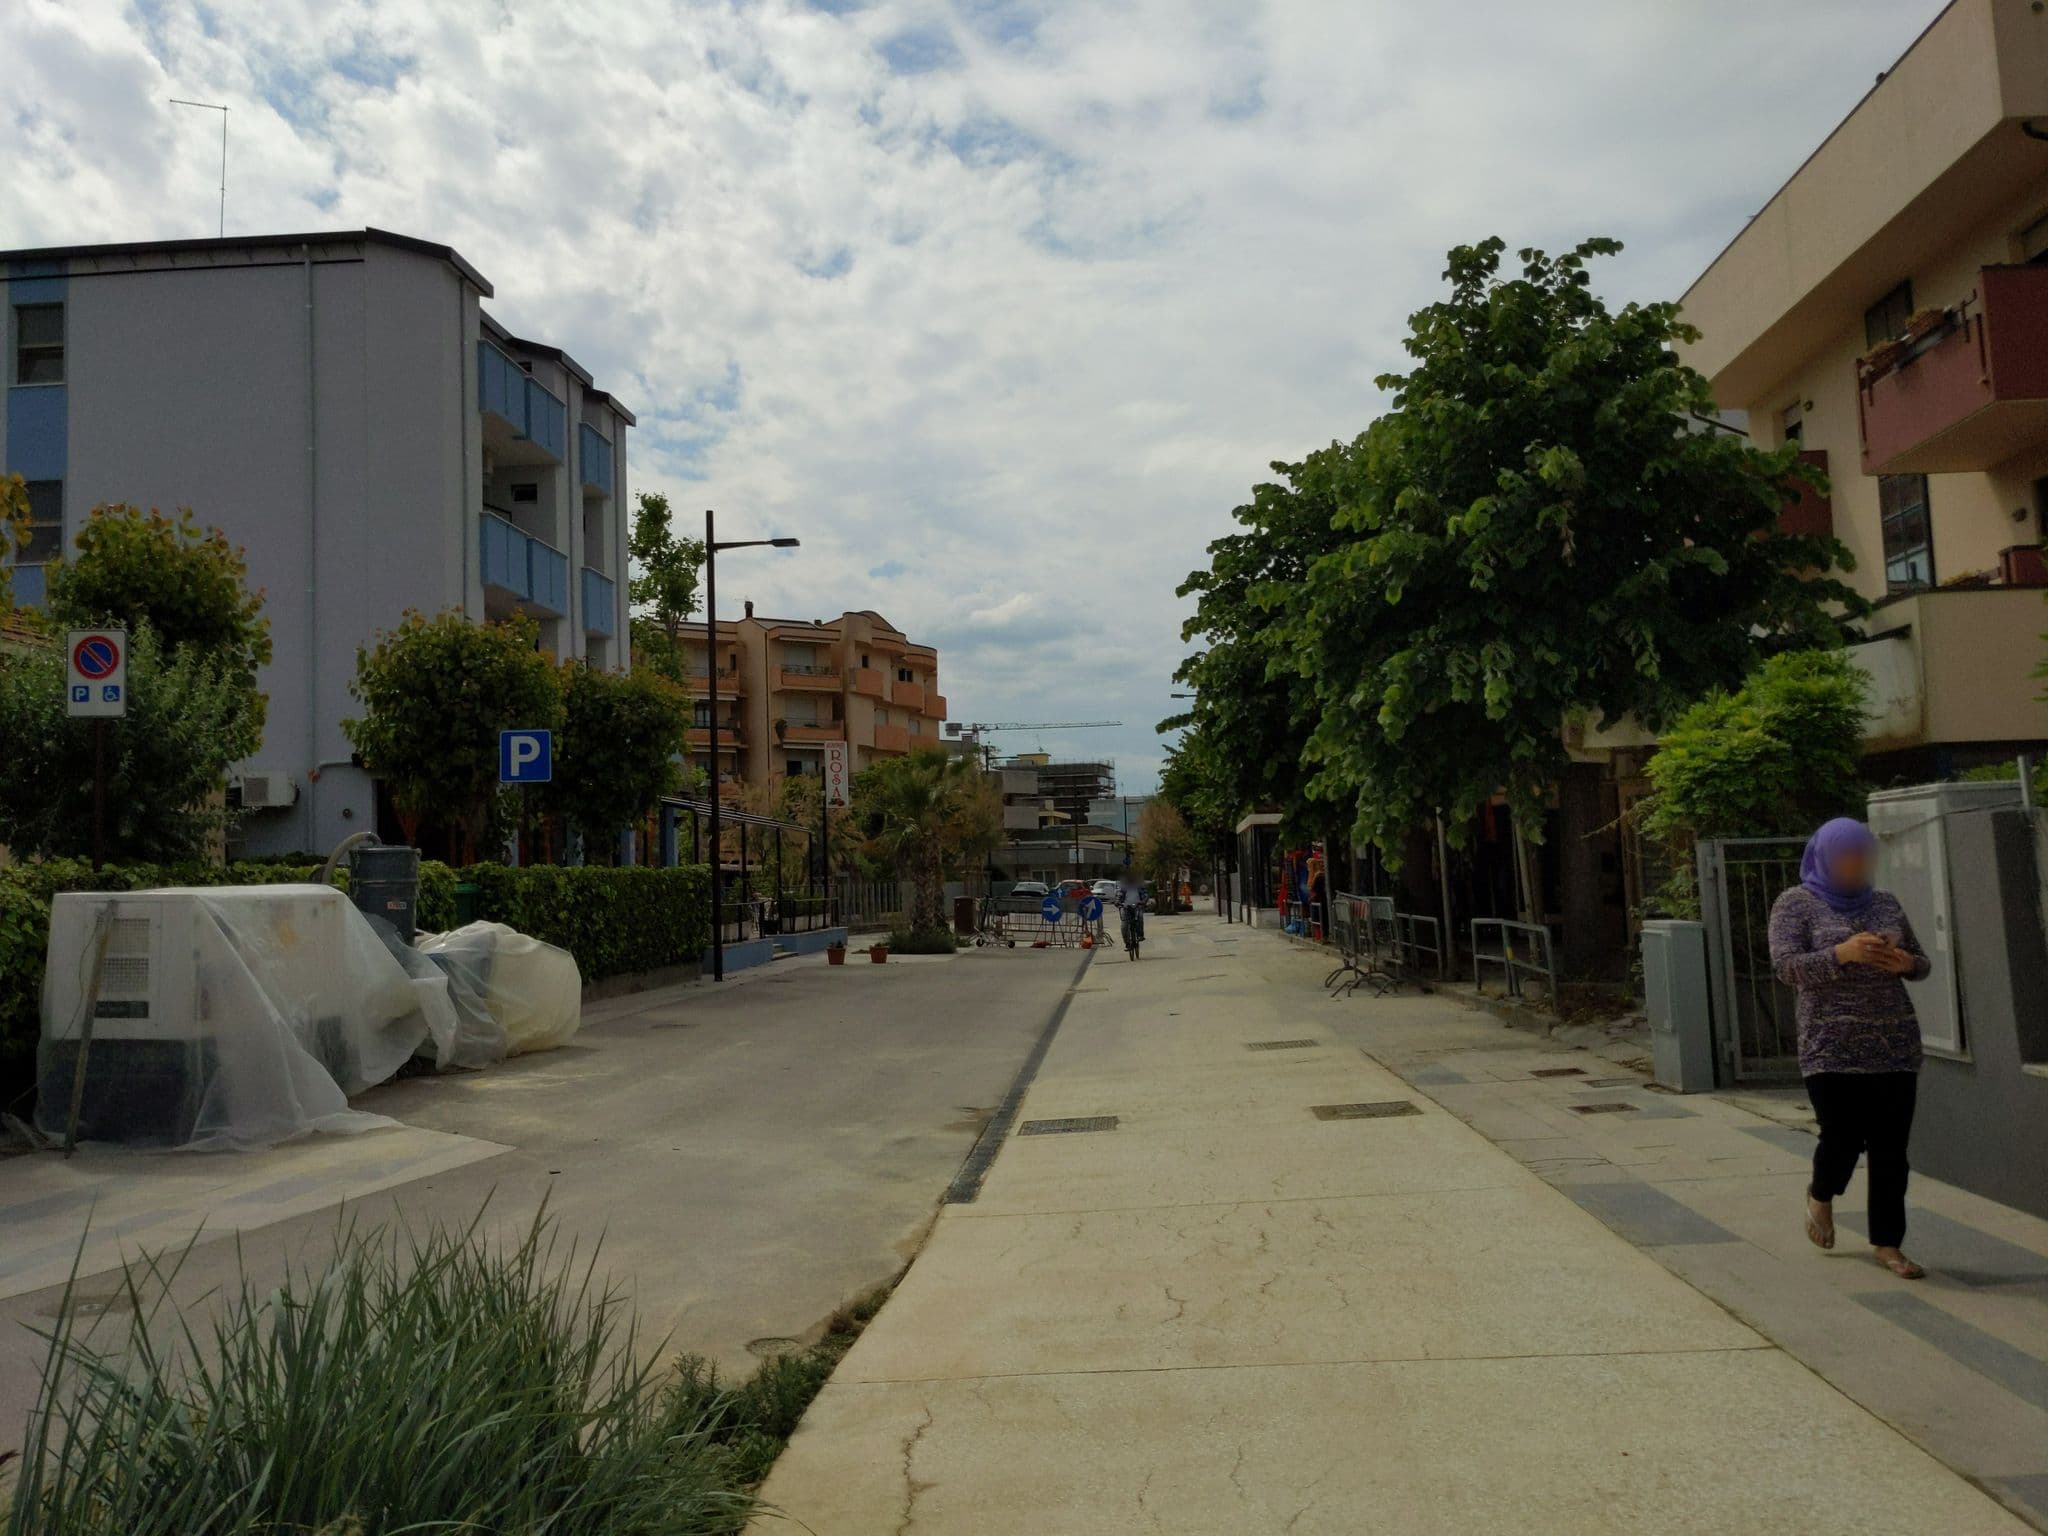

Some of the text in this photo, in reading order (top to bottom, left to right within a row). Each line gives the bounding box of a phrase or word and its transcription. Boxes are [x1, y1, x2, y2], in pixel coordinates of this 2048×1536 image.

[75, 687, 87, 700] P
[511, 736, 540, 776] P
[830, 749, 842, 797] ROSA
